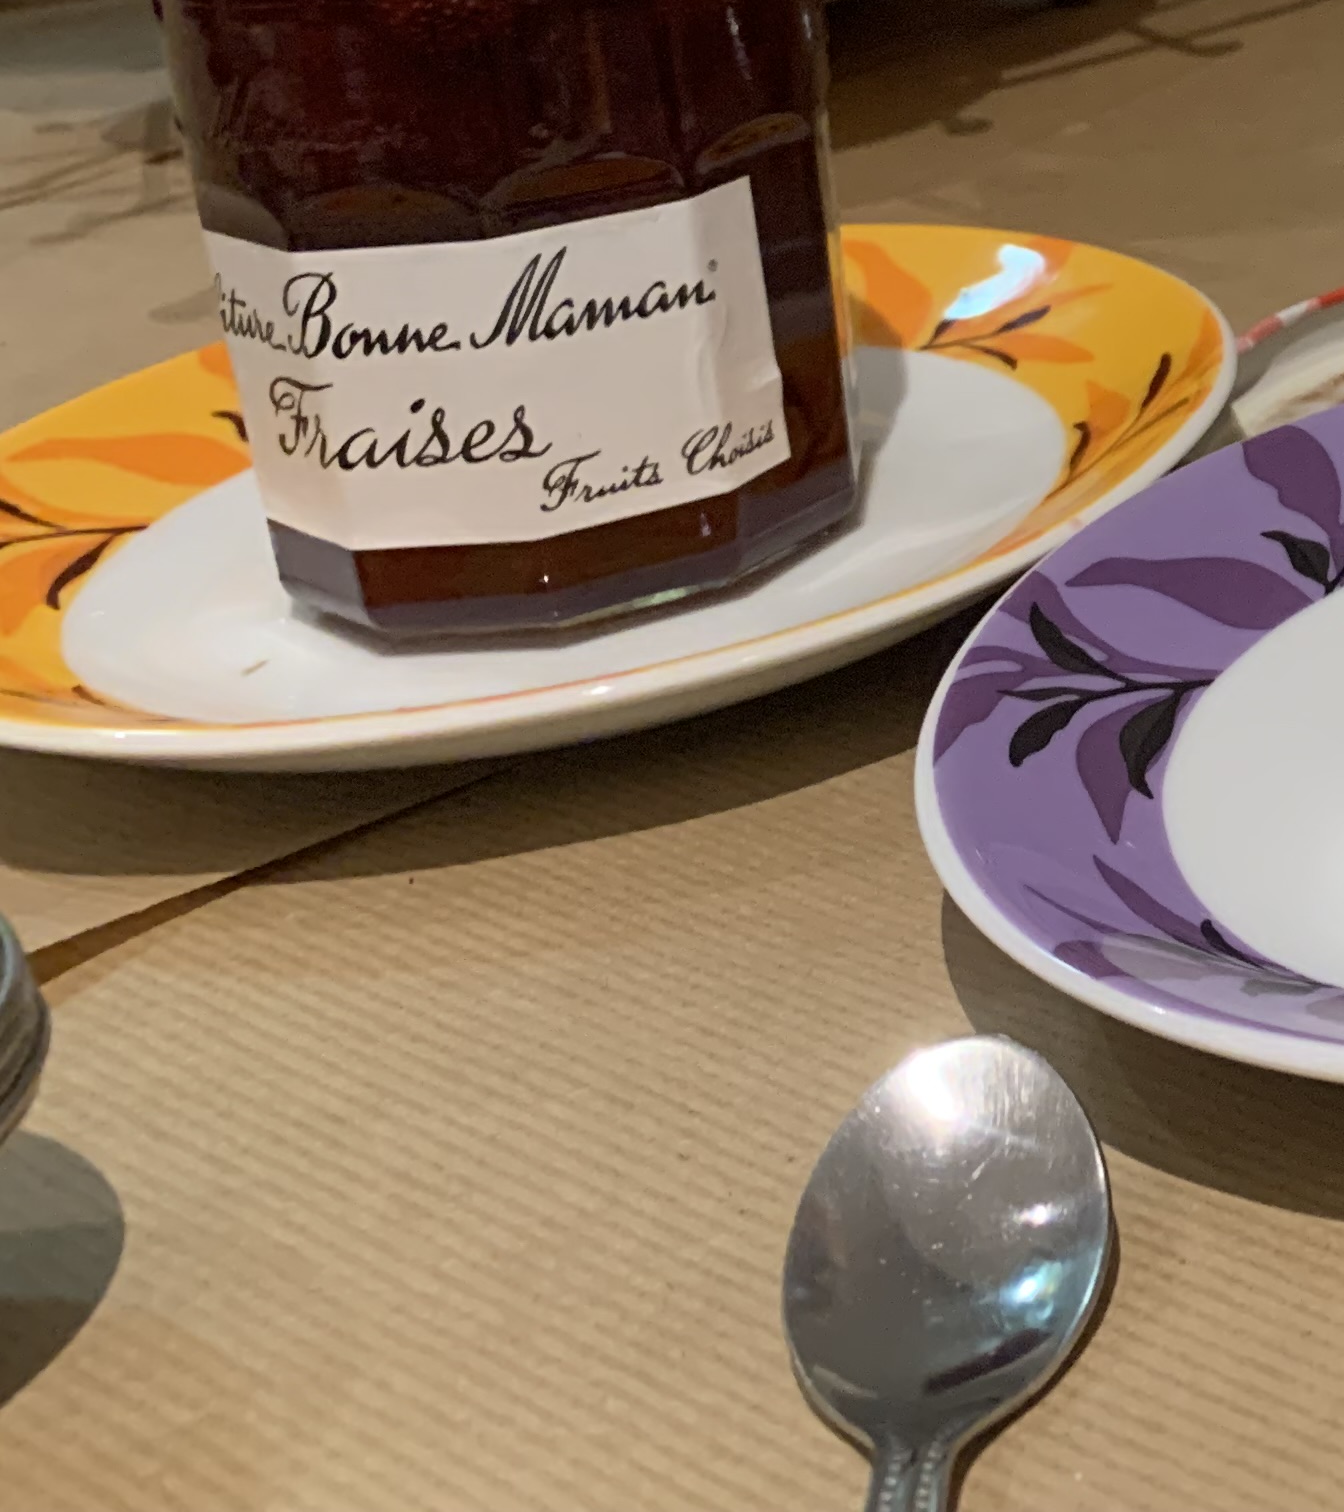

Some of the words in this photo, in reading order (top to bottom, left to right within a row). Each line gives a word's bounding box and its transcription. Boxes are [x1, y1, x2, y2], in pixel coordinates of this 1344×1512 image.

[282, 271, 461, 361] Bonne
[269, 376, 553, 471] Fraises
[540, 449, 664, 513] Fruits
[680, 419, 775, 476] Choisis
